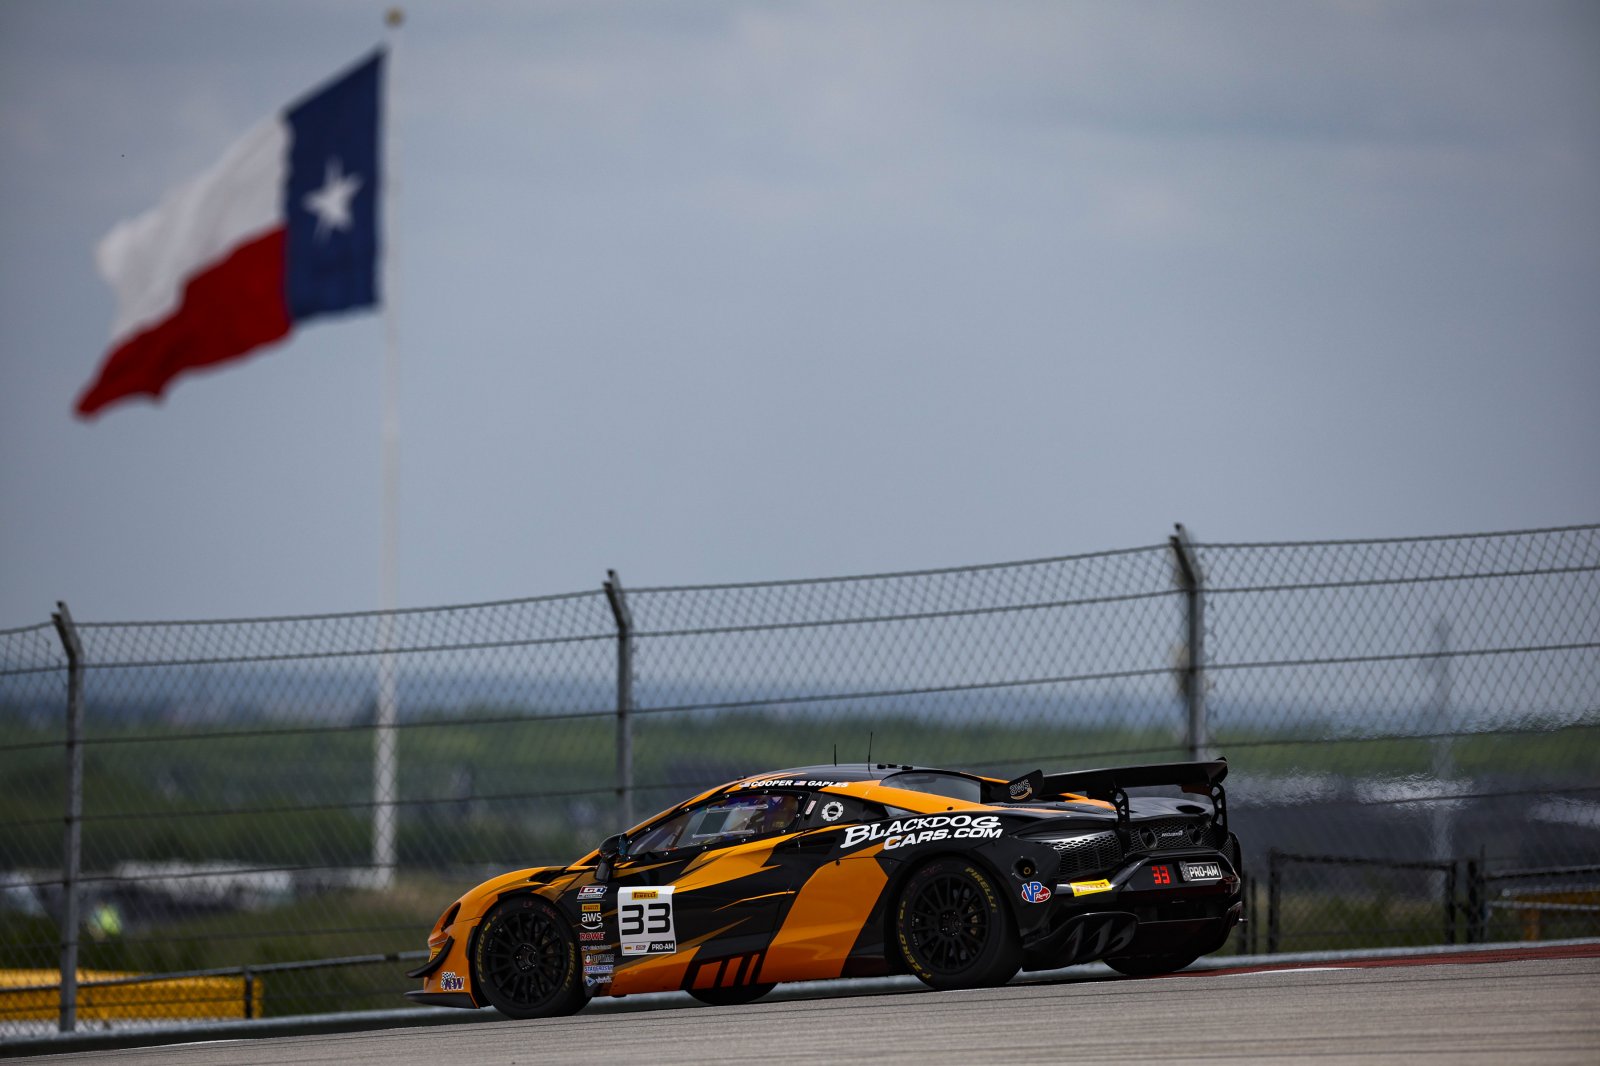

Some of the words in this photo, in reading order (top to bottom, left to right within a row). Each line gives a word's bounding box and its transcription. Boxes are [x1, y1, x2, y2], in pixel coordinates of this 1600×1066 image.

[750, 779, 794, 788] COOPER
[807, 780, 849, 788] GAPLES
[840, 816, 1002, 849] BLACKDOG
[883, 828, 1003, 850] CARS.COM
[1151, 864, 1171, 885] 33
[1188, 865, 1218, 878] PRO-AM
[634, 891, 656, 899] PIRELLI
[964, 866, 997, 913] PIRELLI
[1022, 882, 1042, 901] VP
[582, 912, 602, 922] aws
[622, 903, 670, 936] 33
[580, 932, 606, 940] ROWE
[652, 942, 674, 950] PRO-AM
